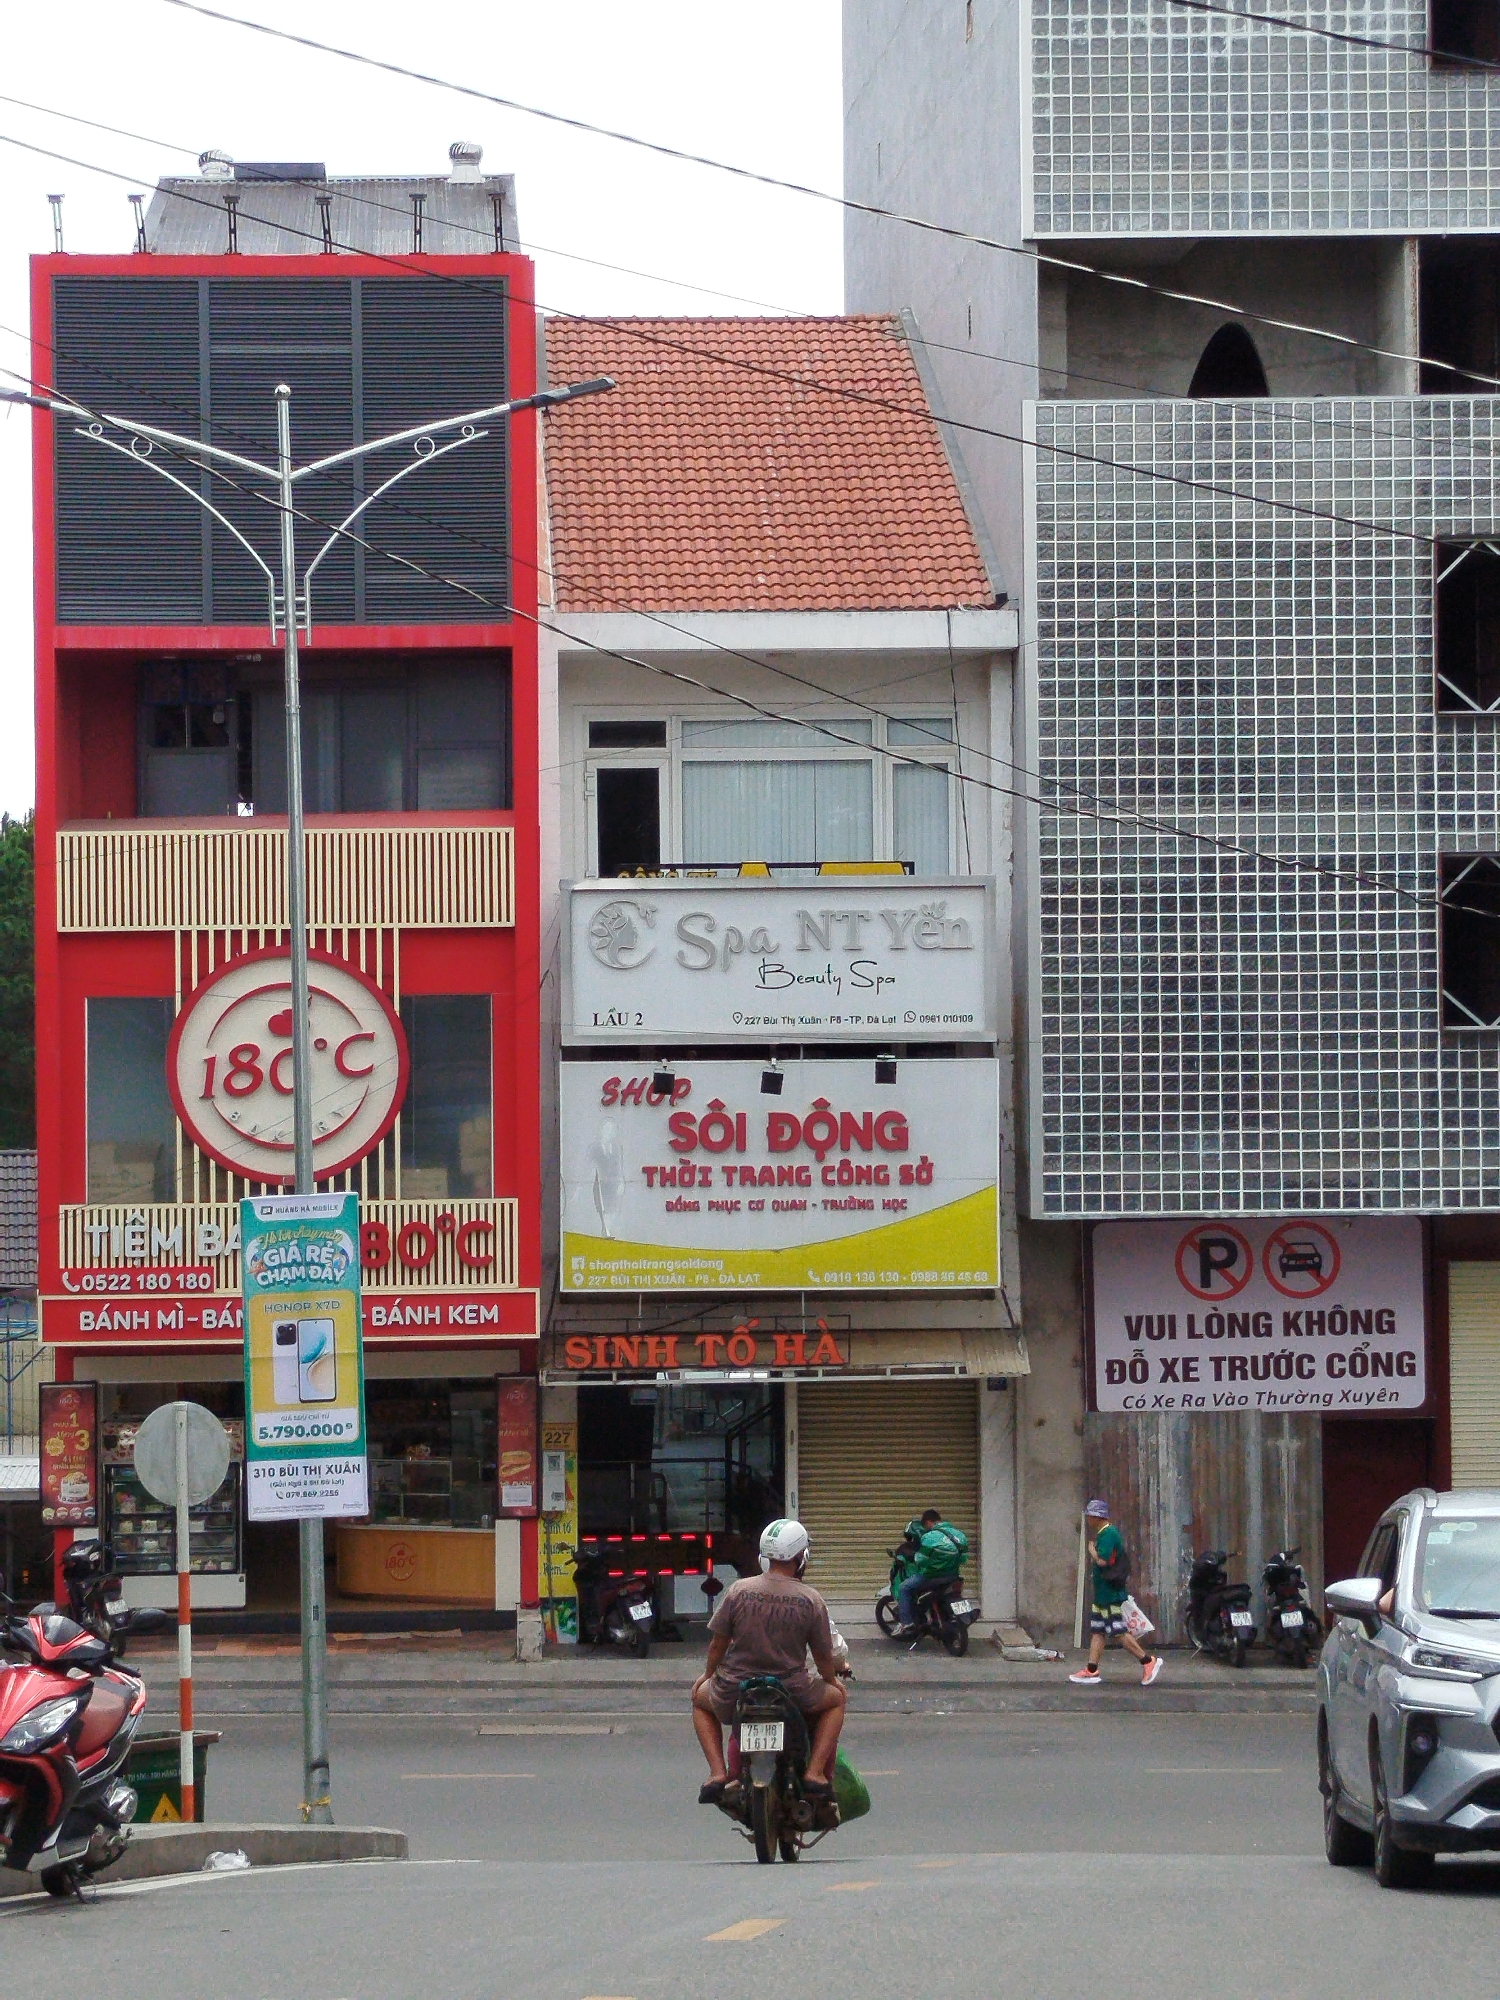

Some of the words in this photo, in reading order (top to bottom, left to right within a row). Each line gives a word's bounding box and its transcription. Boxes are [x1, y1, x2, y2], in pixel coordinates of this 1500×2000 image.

[676, 910, 780, 972] Spa
[797, 909, 871, 951] NT
[755, 958, 842, 994] Beauty
[850, 960, 897, 994] Spa
[635, 1012, 644, 1026] 2
[745, 1016, 761, 1025] 227
[229, 1108, 345, 1143] BAKRY
[668, 1097, 747, 1154] SÔI
[767, 1096, 909, 1163] ĐỘNG
[642, 1158, 712, 1189] THỜI
[722, 1164, 812, 1188] TRANG
[821, 1157, 889, 1187] CÔNG
[899, 1155, 935, 1187] SỞ
[312, 1203, 339, 1212] MOBILE
[708, 1199, 741, 1214] PHỤC
[882, 1198, 908, 1213] HỌC
[86, 1212, 183, 1267] TIỆM
[262, 1240, 303, 1267] GIÁ
[305, 1240, 335, 1264] RẺ
[82, 1273, 131, 1291] 0522
[137, 1273, 172, 1290] 180
[176, 1272, 211, 1290] 180
[256, 1265, 306, 1287] CHẠM
[654, 1272, 685, 1284] XUÂN
[79, 1303, 150, 1331] BÁNH
[372, 1298, 441, 1327] BÁNH
[448, 1304, 499, 1325] KEM
[264, 1302, 312, 1313] HONOR
[315, 1300, 341, 1310] X7D
[1124, 1312, 1177, 1342] VUI
[1187, 1307, 1273, 1340] LÒNG
[1282, 1303, 1396, 1338] KHÔNG
[565, 1332, 679, 1370] SINH
[695, 1318, 758, 1368] TỐ
[772, 1320, 847, 1367] HÀ
[1105, 1348, 1148, 1385] ĐỖ
[1158, 1355, 1199, 1384] XE
[1209, 1347, 1316, 1383] TRƯỚC
[1325, 1341, 1417, 1380] CỔNG
[1122, 1391, 1147, 1410] Có
[1151, 1394, 1175, 1409] Xe
[1181, 1393, 1206, 1408] Ra
[1212, 1390, 1249, 1408] Vào
[1255, 1387, 1333, 1409] Thường
[1338, 1386, 1400, 1408] Xuyên
[75, 1429, 90, 1451] 3
[544, 1431, 571, 1445] 227
[253, 1466, 276, 1479] 310
[279, 1463, 299, 1478] BÙI
[302, 1464, 322, 1479] THỊ
[325, 1460, 361, 1475] XUÂN
